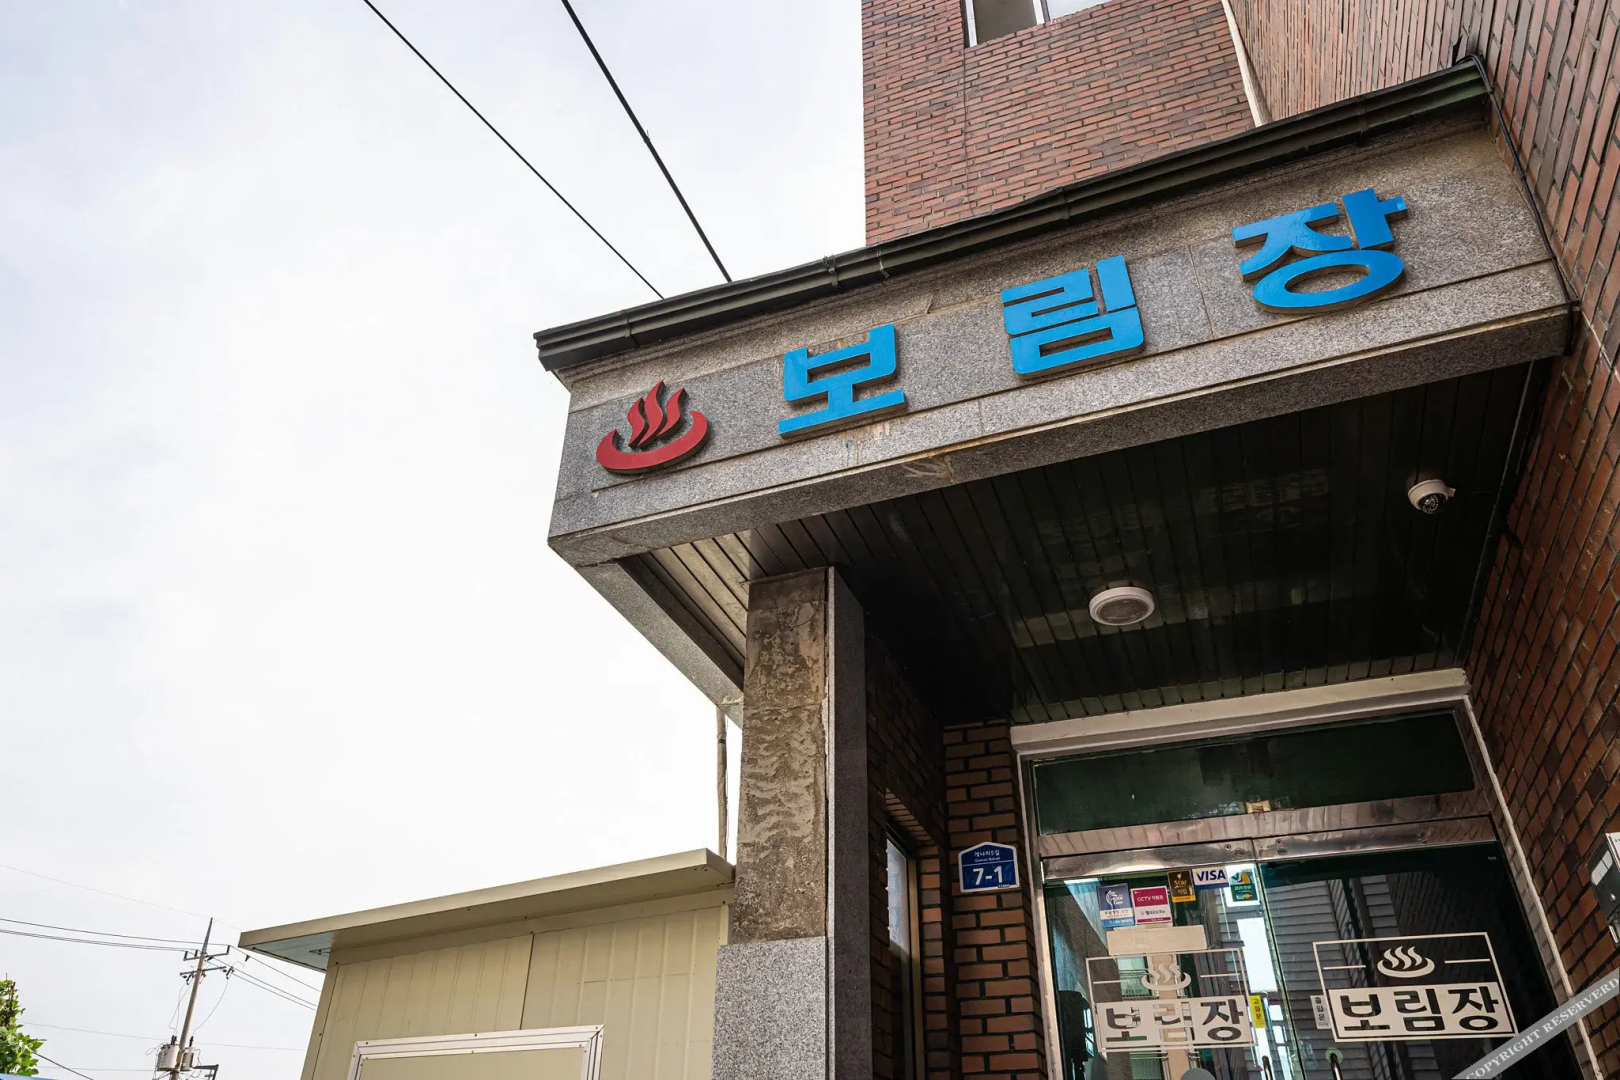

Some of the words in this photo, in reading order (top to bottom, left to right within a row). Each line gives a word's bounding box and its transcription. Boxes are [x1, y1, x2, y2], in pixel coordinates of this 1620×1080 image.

[778, 187, 1407, 437] 보림장
[973, 865, 1003, 886] 7-1
[1196, 869, 1227, 882] VISA
[1106, 999, 1244, 1043] 보림장
[1340, 986, 1499, 1032] 보림장
